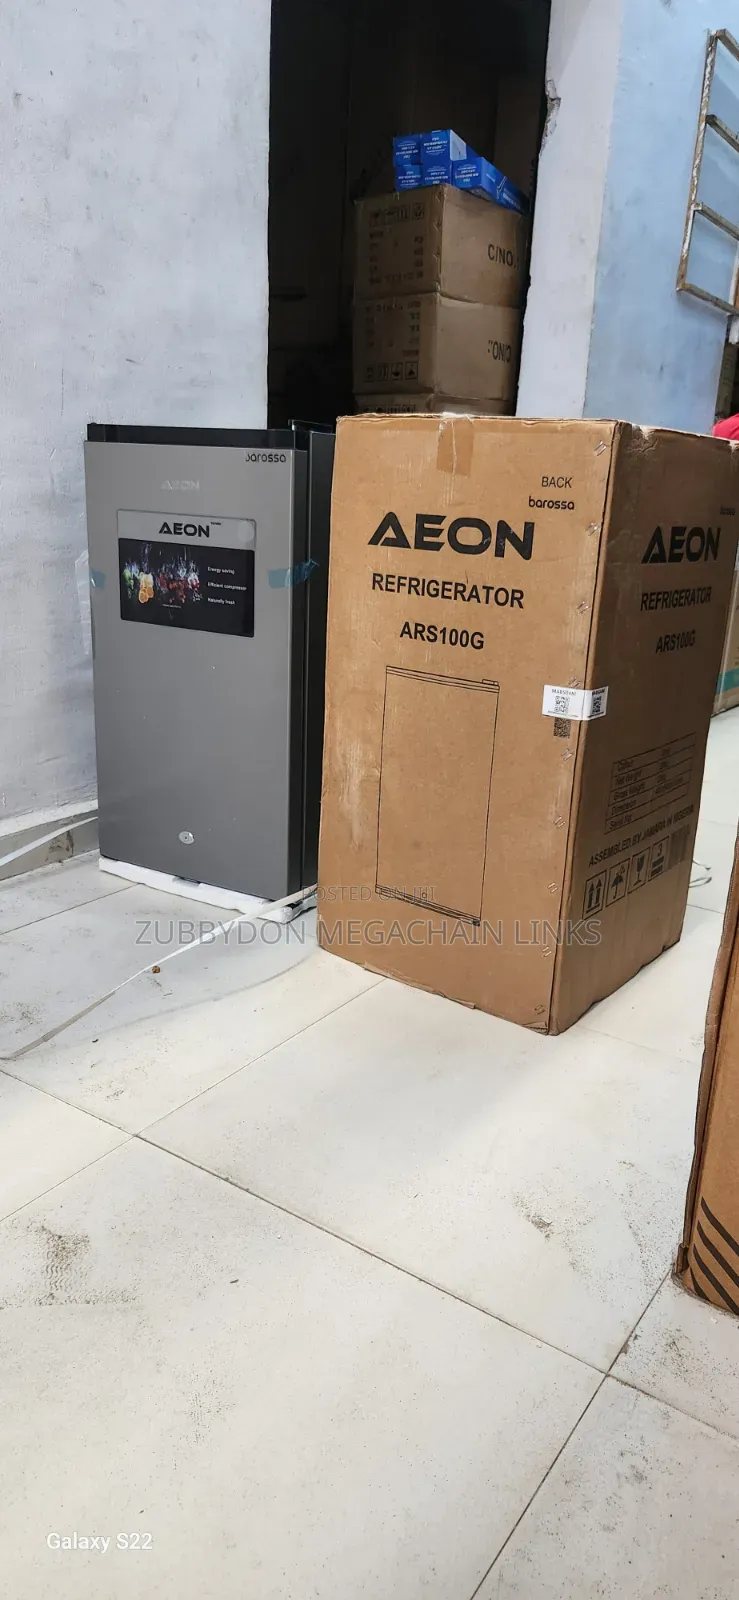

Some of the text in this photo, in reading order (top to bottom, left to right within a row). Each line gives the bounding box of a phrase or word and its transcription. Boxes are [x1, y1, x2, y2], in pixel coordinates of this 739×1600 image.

[541, 476, 573, 489] BACK
[528, 496, 575, 511] barossa
[158, 521, 210, 538] AEON
[367, 511, 536, 561] AEON
[640, 526, 721, 565] AEON
[372, 572, 525, 609] REFRIGERATOR
[640, 586, 712, 612] REFRIGERATOR
[400, 621, 485, 650] ARS100G
[655, 630, 696, 654] ARS100G
[588, 838, 632, 868] ASSEMBLED
[632, 833, 642, 846] BY
